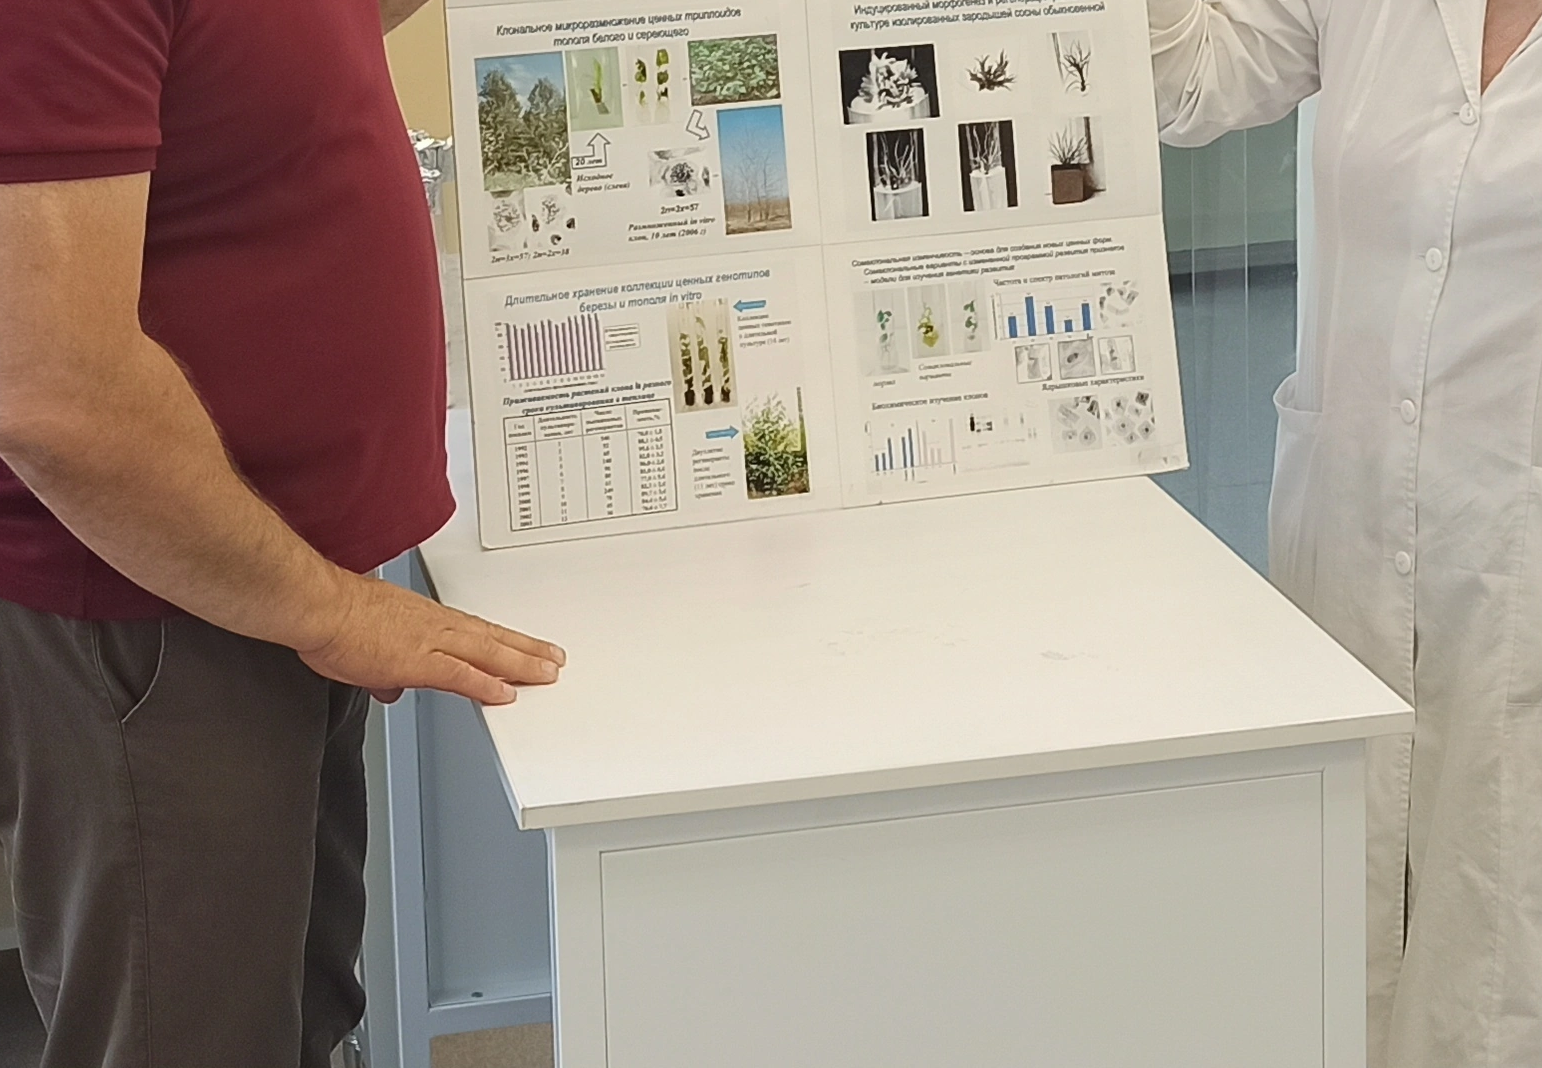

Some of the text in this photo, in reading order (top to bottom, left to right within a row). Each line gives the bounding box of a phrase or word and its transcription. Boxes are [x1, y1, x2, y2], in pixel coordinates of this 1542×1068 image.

[851, 1, 1105, 31] культуре изолированных зародышей сосны обыкновенной
[854, 0, 930, 15] Индуцированный
[497, 7, 741, 36] Клональное микроразмножение ценных триплоидов
[554, 34, 590, 47] тополя
[592, 31, 625, 43] белого
[636, 28, 689, 41] сереющего
[575, 158, 585, 166] 20
[505, 268, 770, 308] Длительное хранение коллекции ценных генотипов
[579, 290, 702, 313] березы и тополя in vitro
